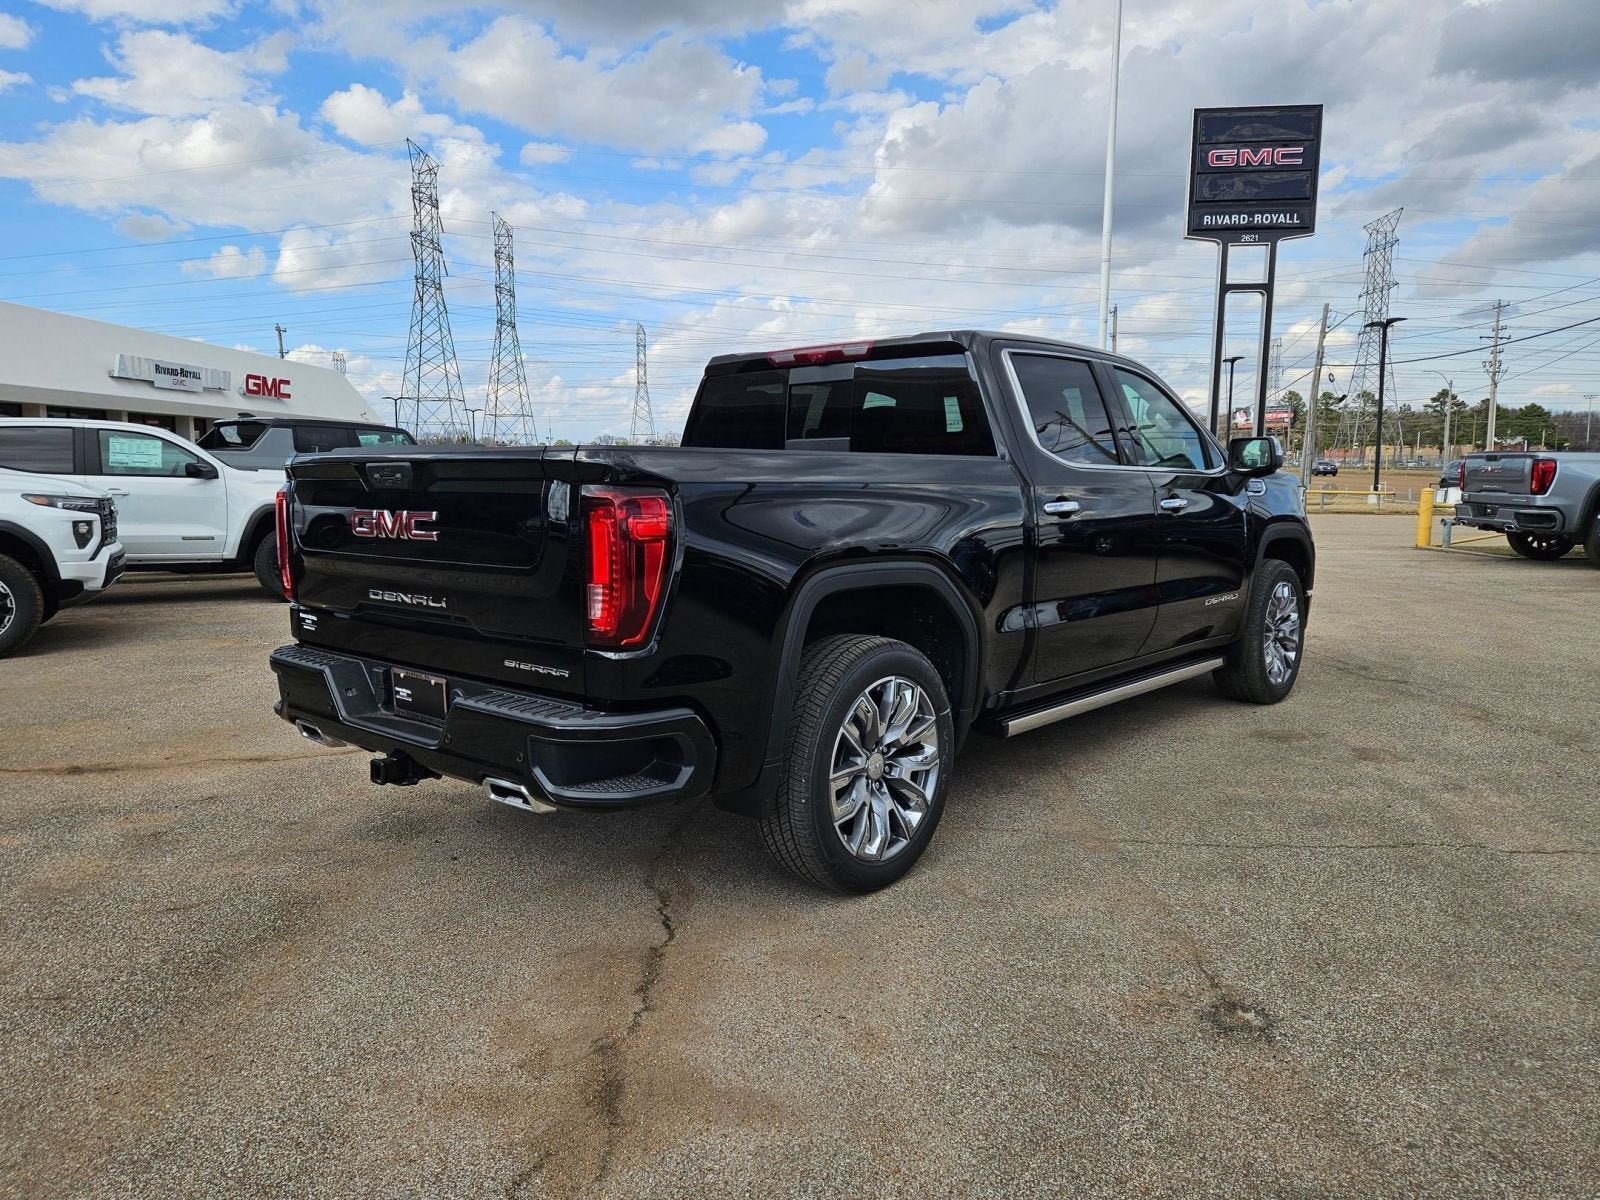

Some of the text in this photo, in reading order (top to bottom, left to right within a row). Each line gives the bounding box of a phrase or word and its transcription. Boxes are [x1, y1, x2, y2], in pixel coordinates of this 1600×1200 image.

[1208, 147, 1304, 167] GMC
[1203, 213, 1300, 226] RIVARD-ROYALL
[245, 373, 292, 399] GMC
[351, 508, 441, 542] GMC
[368, 588, 447, 609] DENALI
[503, 658, 570, 678] SIERRA
